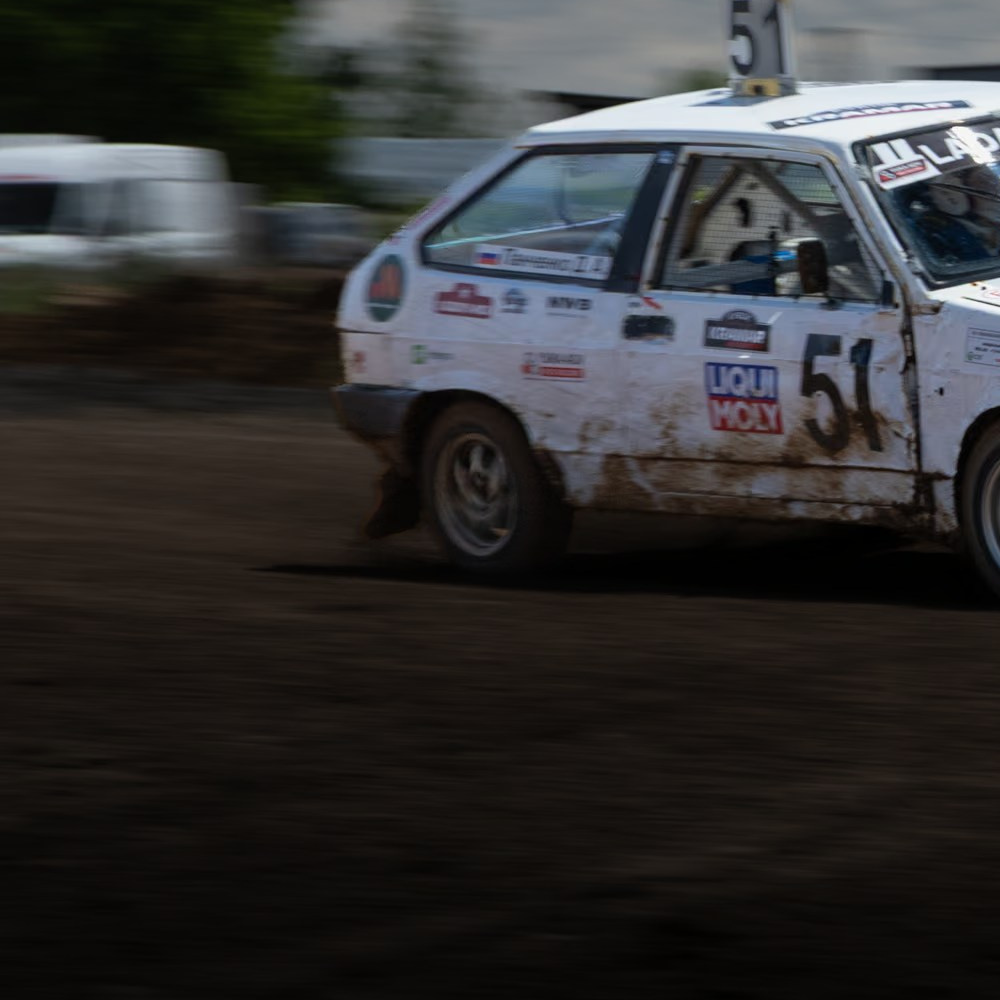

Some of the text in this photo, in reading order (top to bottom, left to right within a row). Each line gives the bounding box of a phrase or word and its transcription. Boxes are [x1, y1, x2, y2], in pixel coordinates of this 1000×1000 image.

[731, 0, 785, 75] 51
[713, 400, 779, 431] MOLY
[801, 333, 883, 452] 51
